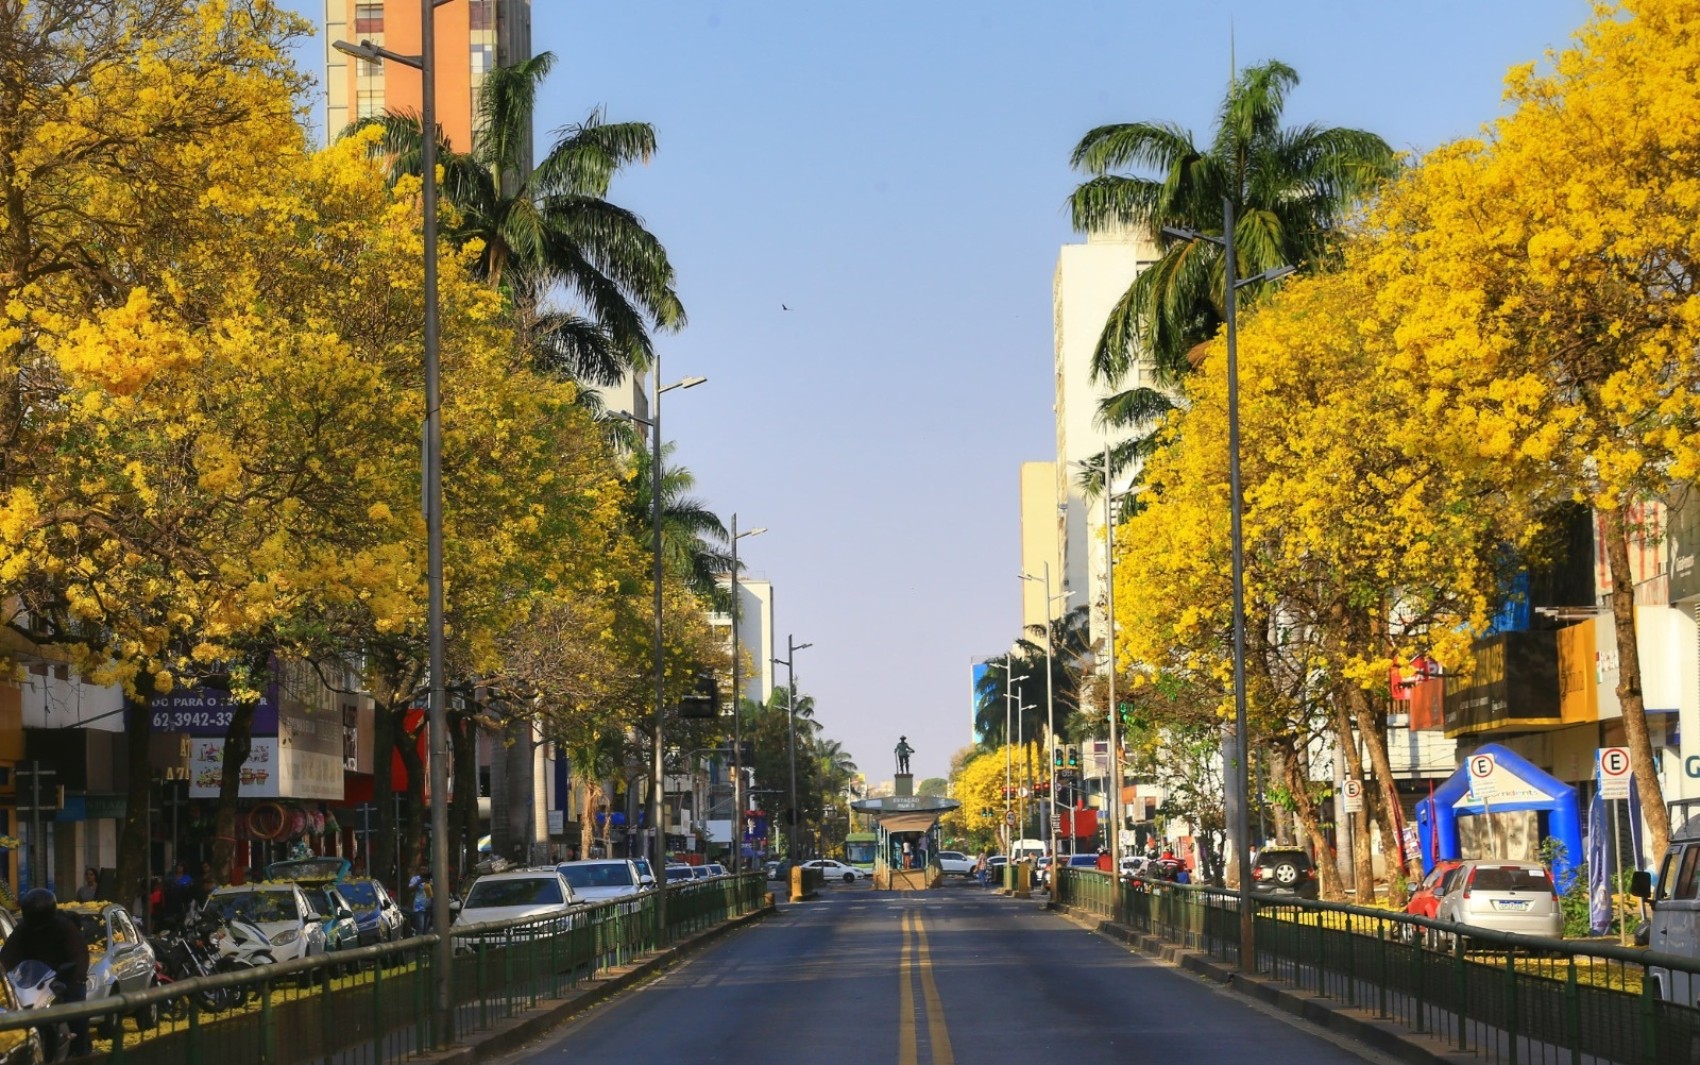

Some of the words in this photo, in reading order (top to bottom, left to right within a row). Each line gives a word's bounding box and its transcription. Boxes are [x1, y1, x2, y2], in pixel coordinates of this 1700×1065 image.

[173, 697, 204, 707] PARA
[207, 697, 217, 707] O
[153, 712, 169, 727] 62
[174, 711, 233, 727] 3942-33
[1478, 759, 1487, 774] E
[1611, 754, 1621, 771] E
[1348, 784, 1355, 794] E
